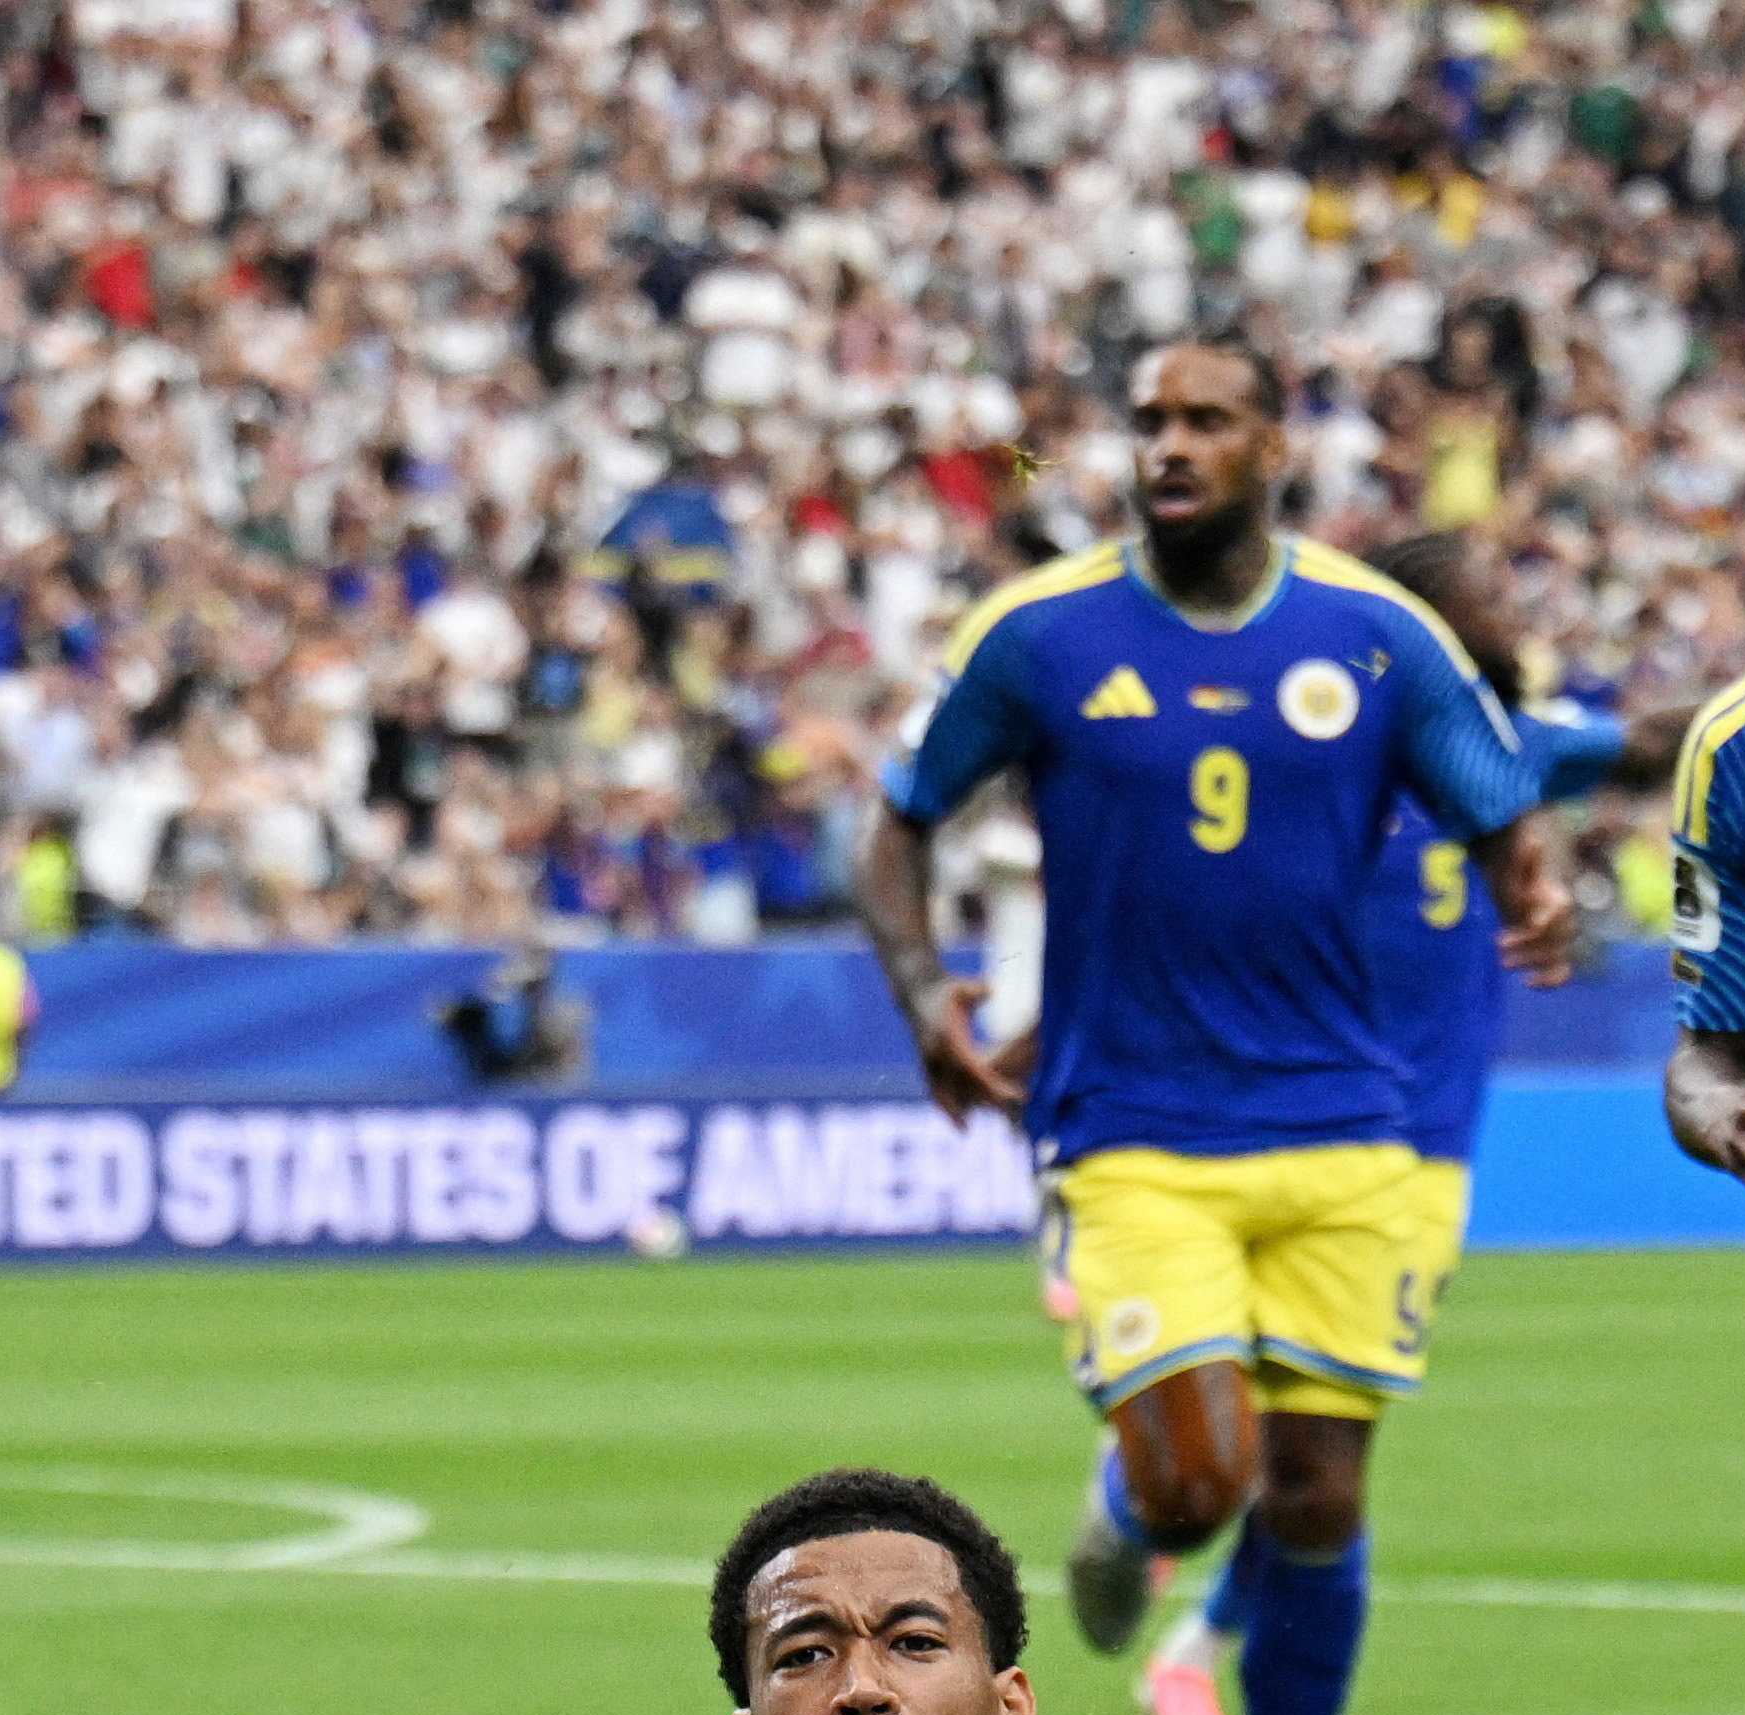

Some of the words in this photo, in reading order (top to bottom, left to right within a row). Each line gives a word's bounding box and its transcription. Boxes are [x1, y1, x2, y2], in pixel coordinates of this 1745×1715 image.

[1189, 746, 1250, 854] 9
[1419, 839, 1468, 931] 5
[158, 1106, 538, 1247] STATES
[545, 1104, 692, 1241] OF
